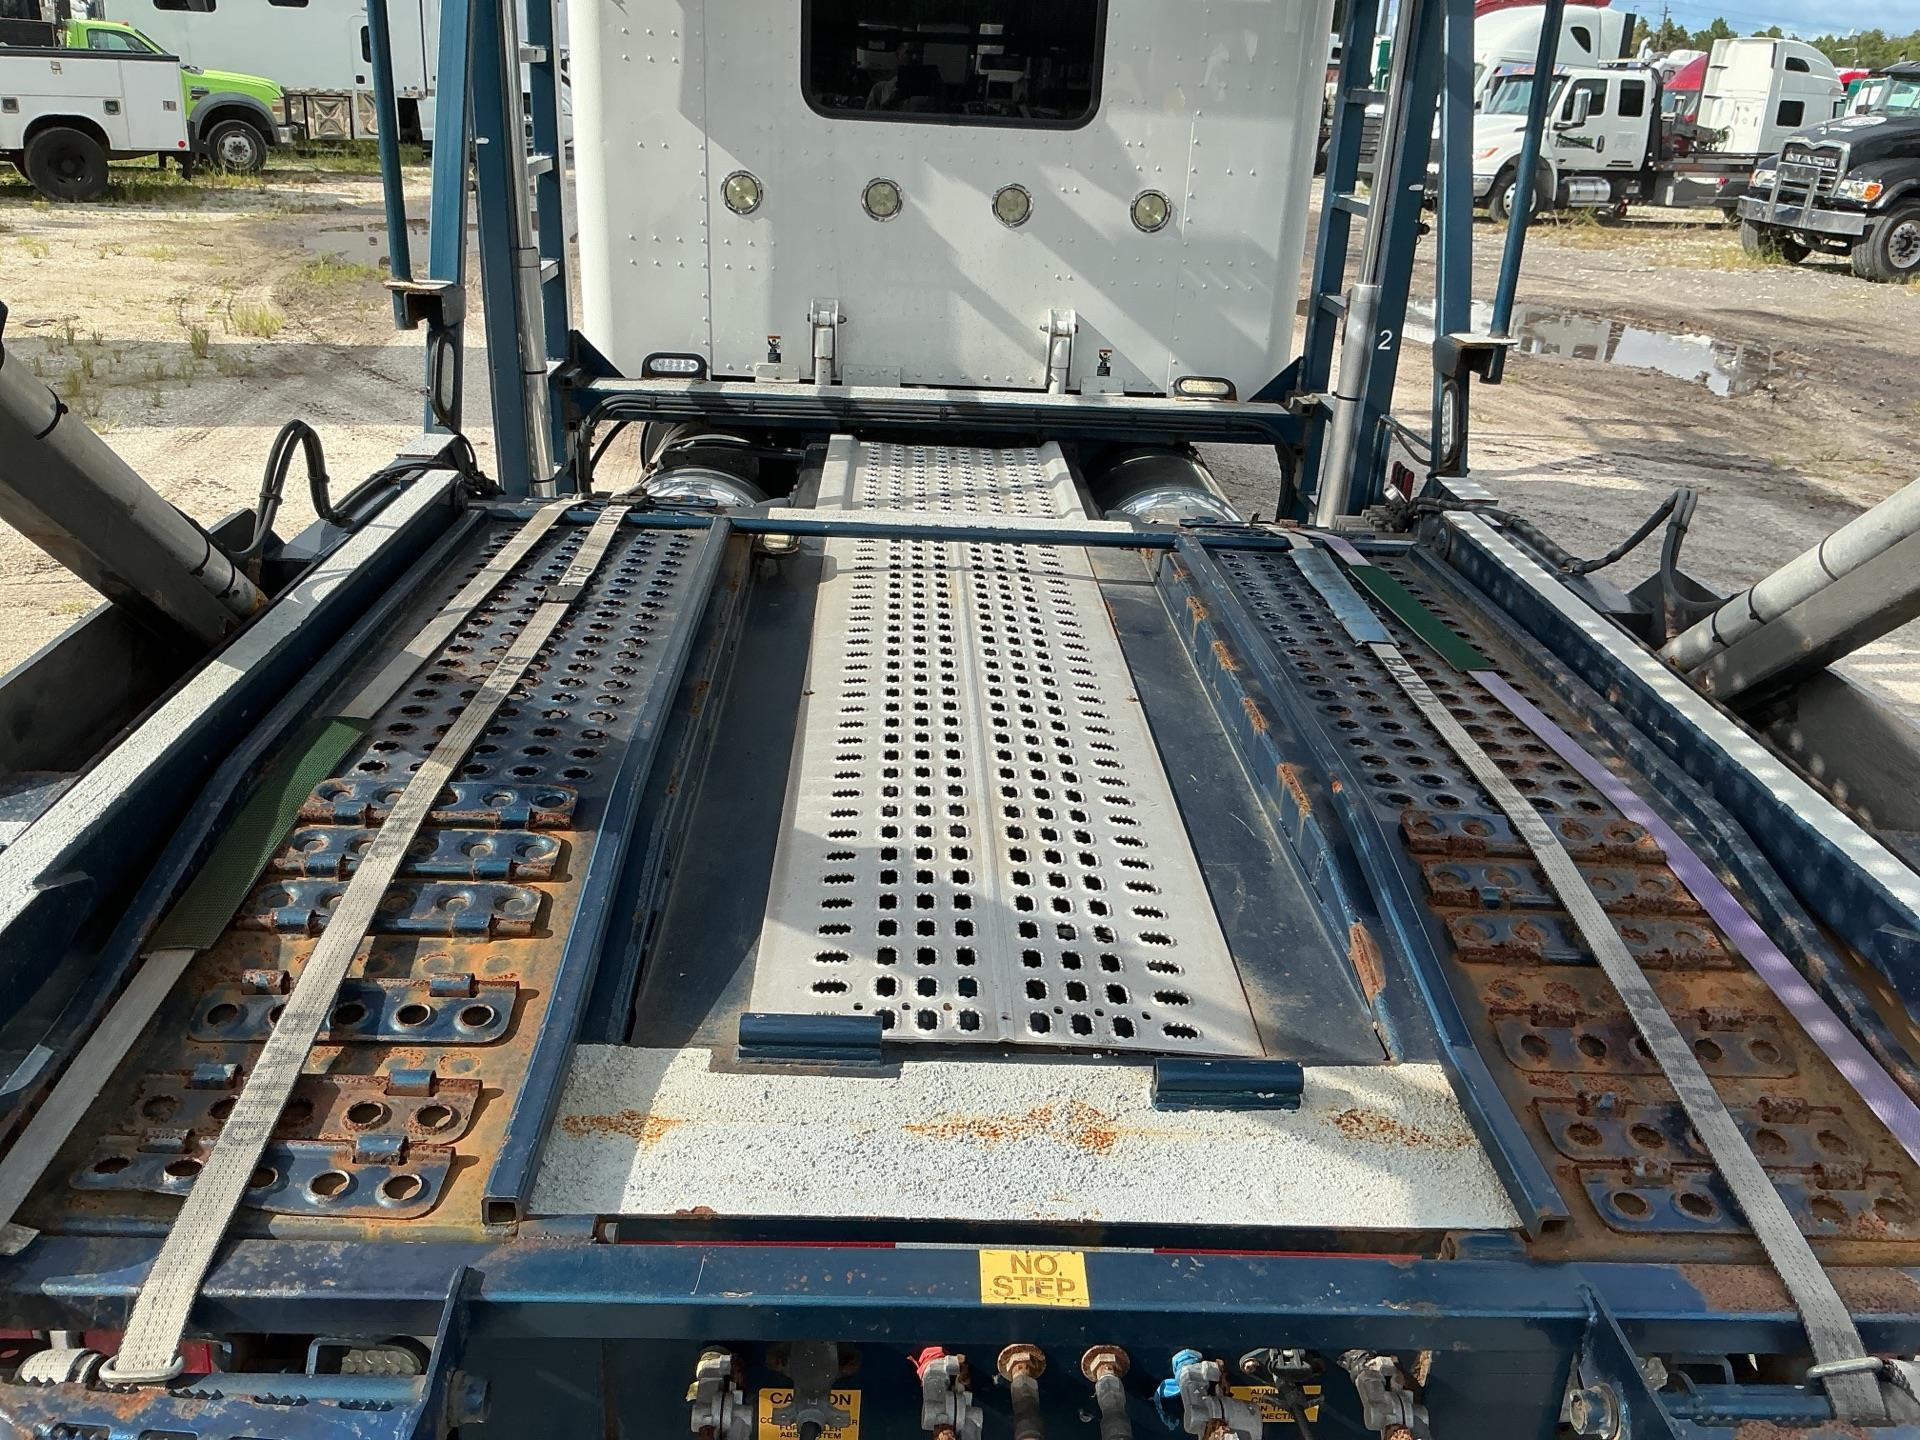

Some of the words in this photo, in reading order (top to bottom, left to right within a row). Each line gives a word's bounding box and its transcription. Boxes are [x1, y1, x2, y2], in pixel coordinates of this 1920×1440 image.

[1785, 151, 1837, 167] MACK
[1378, 330, 1392, 350] 2
[1010, 1253, 1058, 1275] NO
[992, 1275, 1076, 1297] STEP
[769, 1392, 852, 1405] CAON
